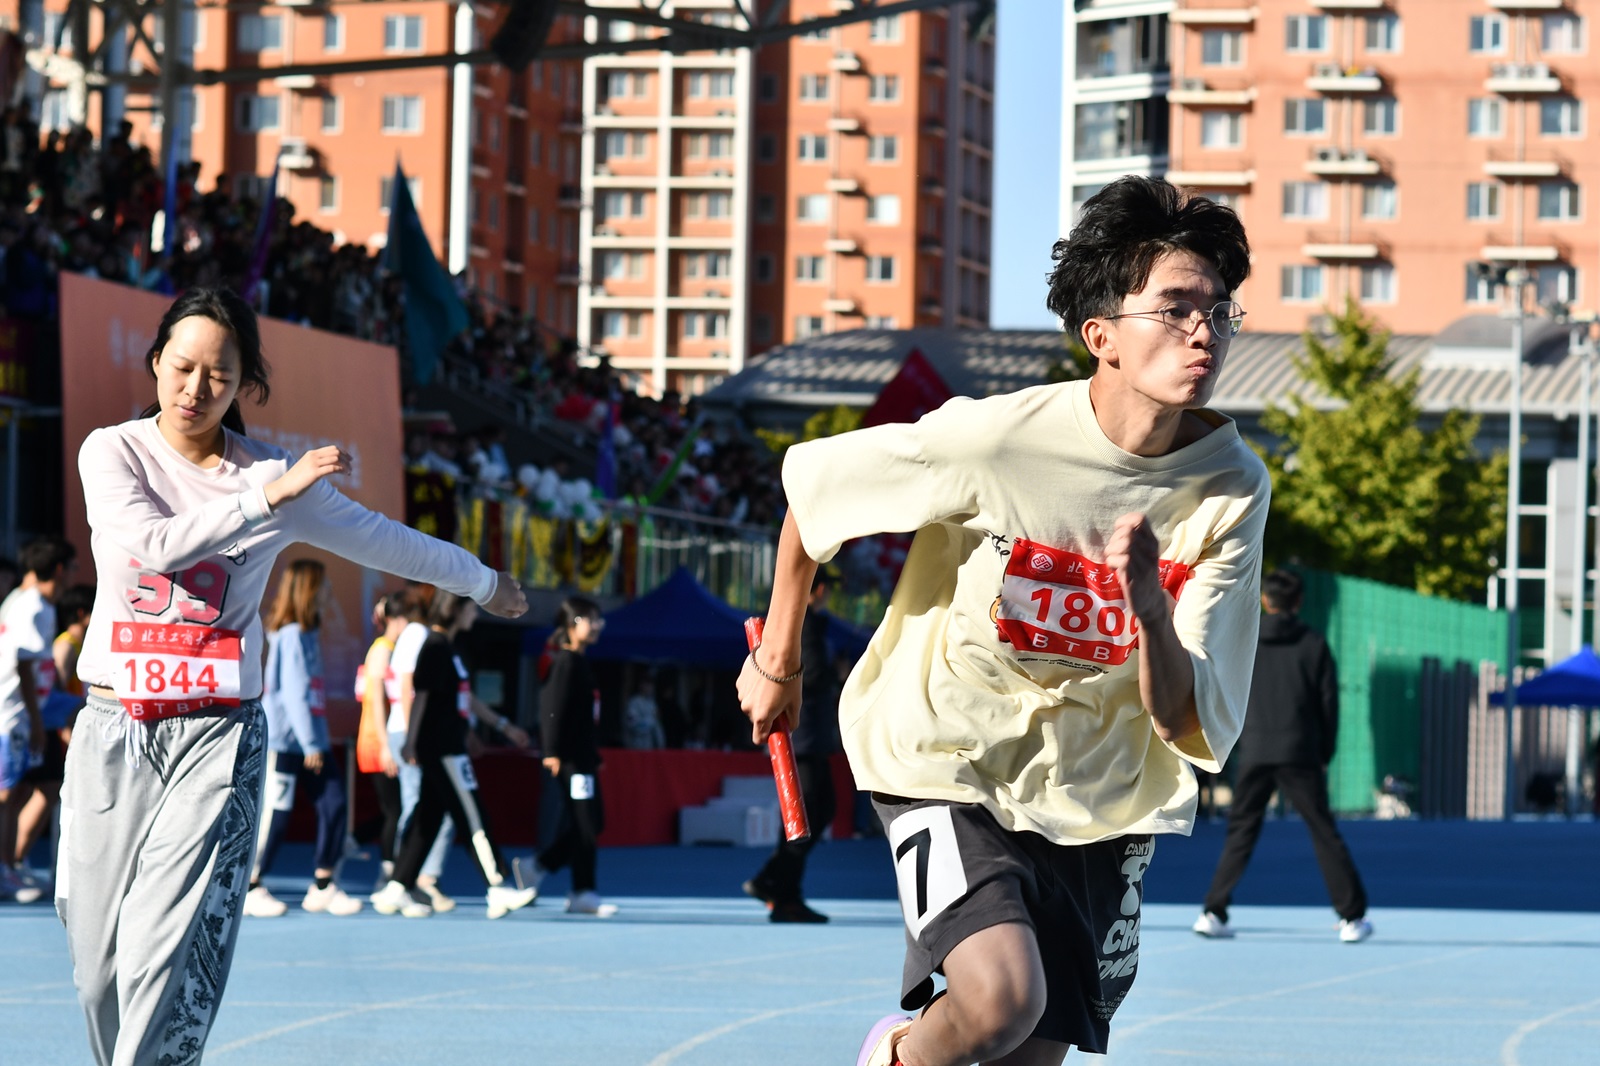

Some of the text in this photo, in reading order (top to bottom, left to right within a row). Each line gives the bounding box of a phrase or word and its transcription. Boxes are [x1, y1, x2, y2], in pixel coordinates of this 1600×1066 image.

[141, 628, 221, 648] 北京工商大学
[124, 659, 219, 694] 1844
[896, 827, 932, 920] 7
